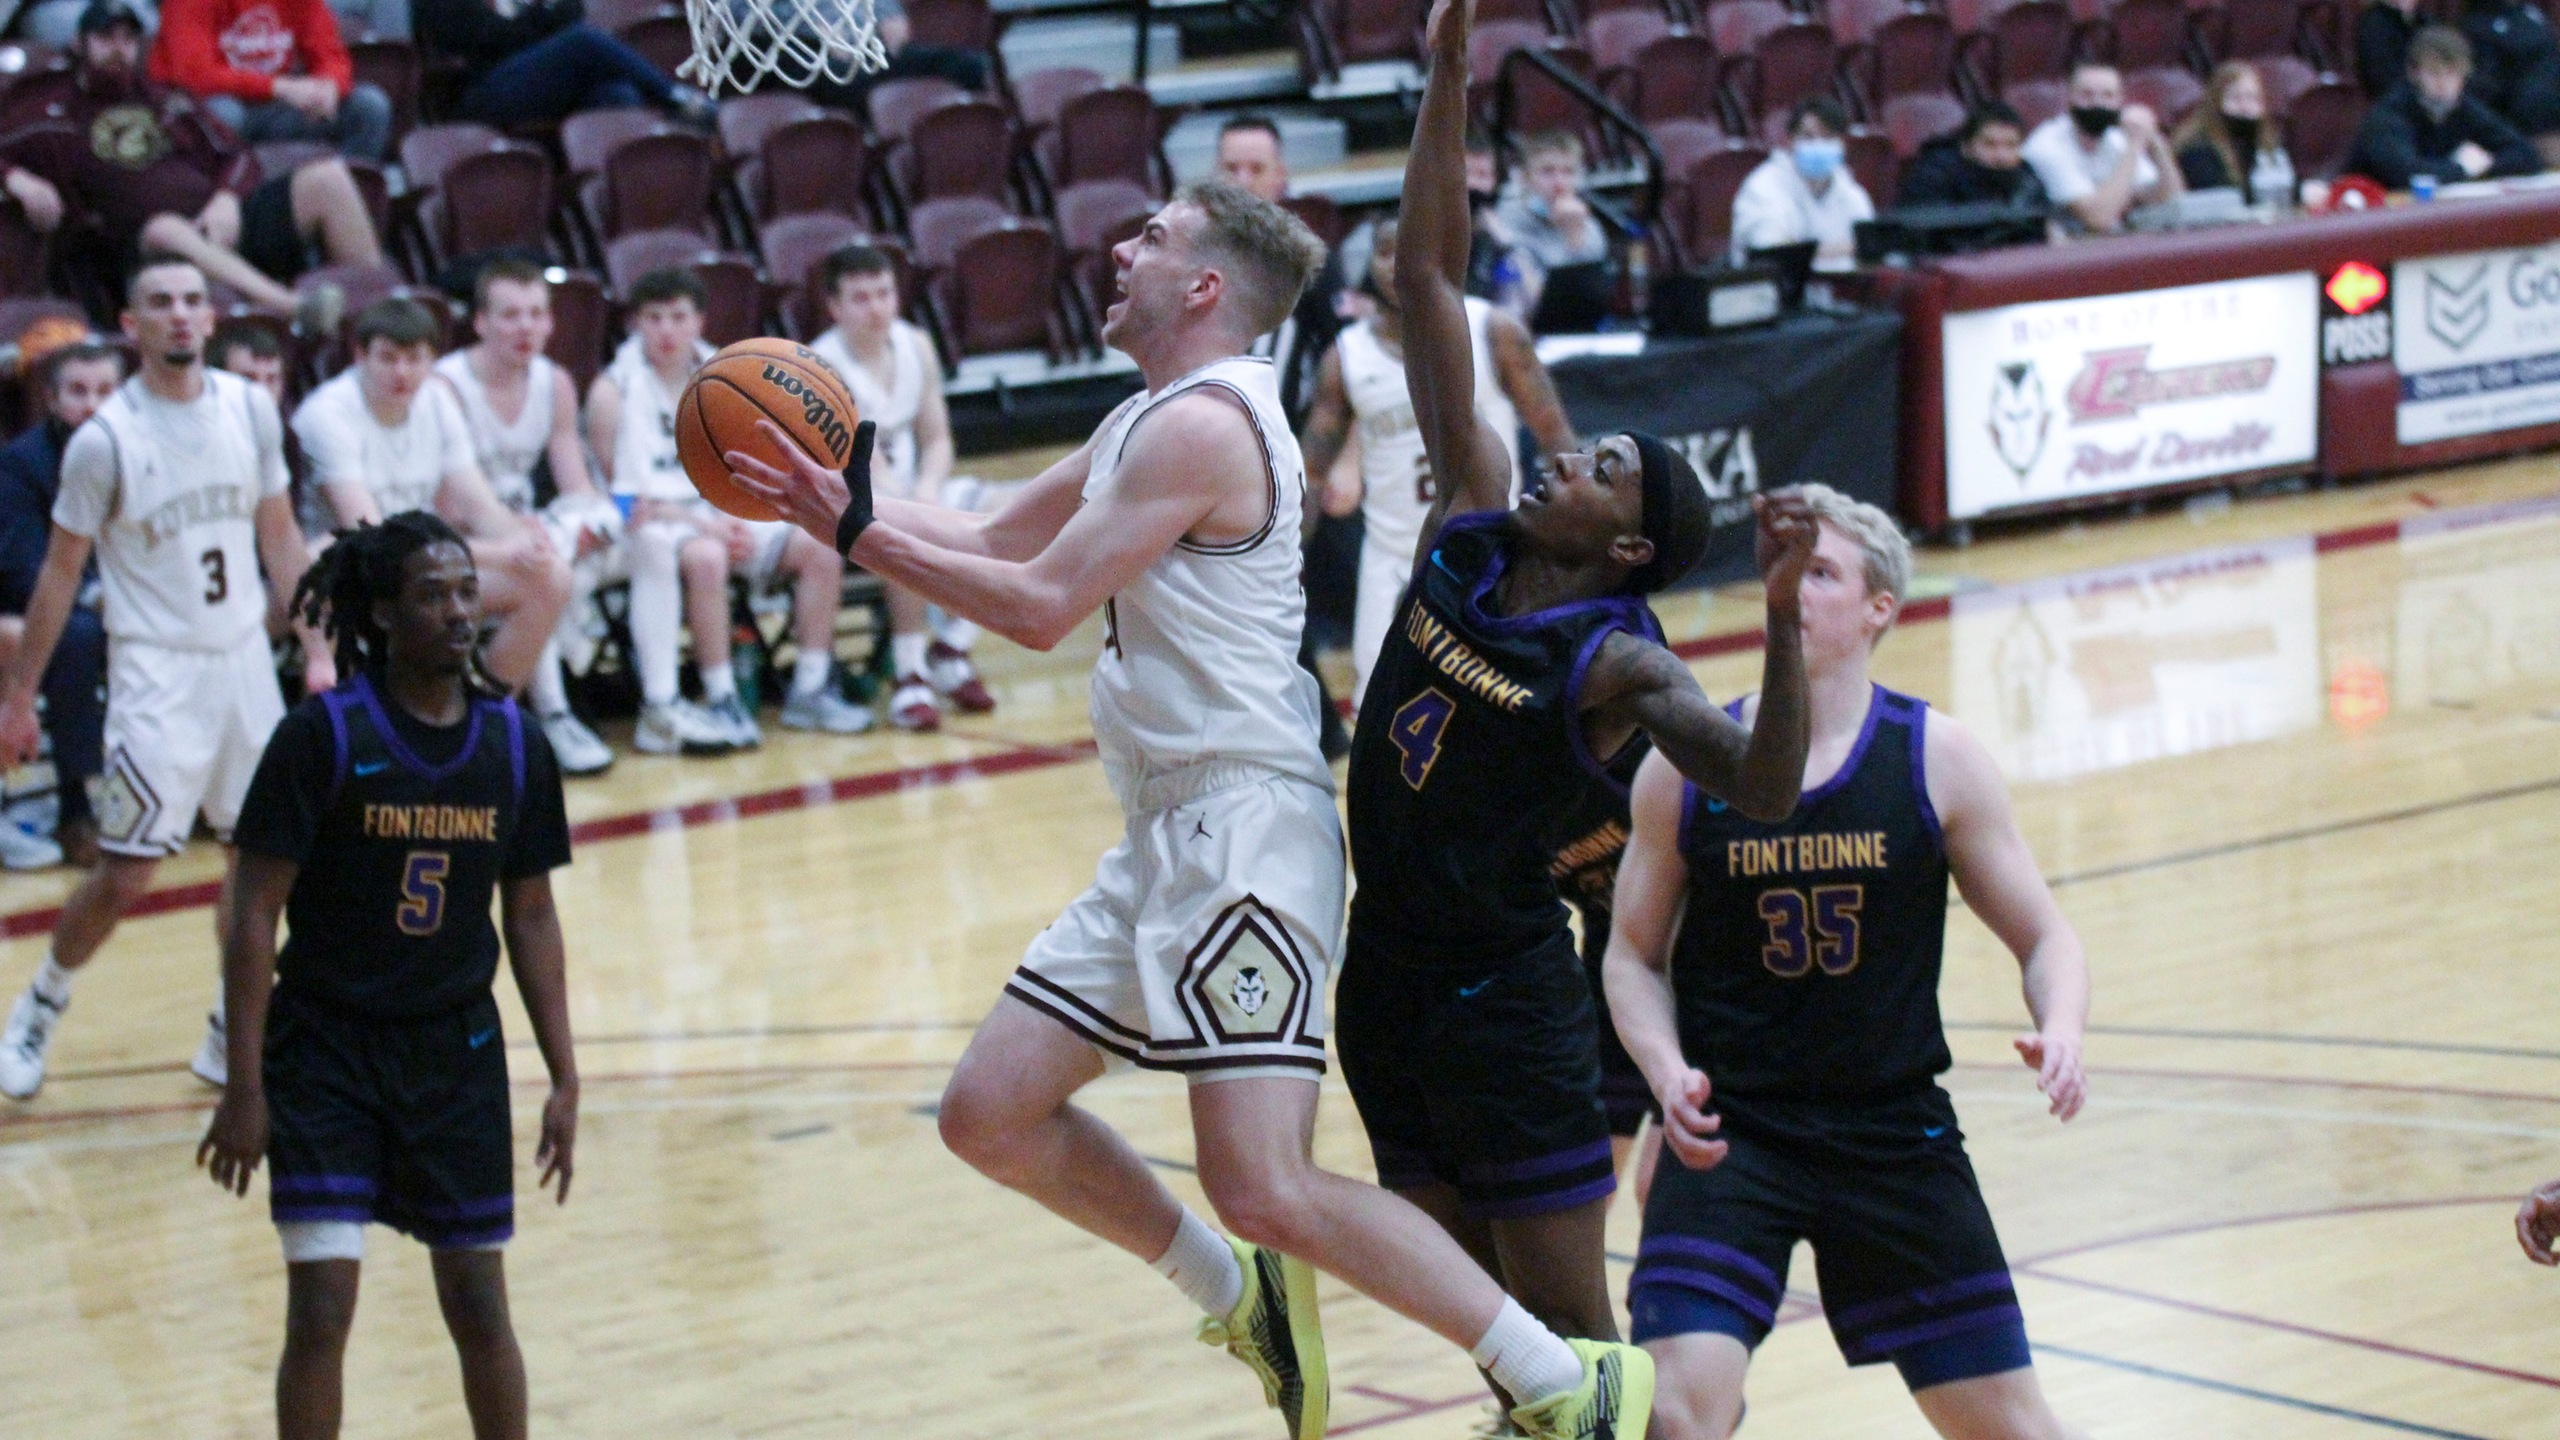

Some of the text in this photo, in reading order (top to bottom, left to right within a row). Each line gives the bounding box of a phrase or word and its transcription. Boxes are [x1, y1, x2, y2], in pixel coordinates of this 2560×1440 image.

[2323, 312, 2389, 364] POSS
[762, 363, 850, 465] Wilson
[1664, 426, 1758, 499] KA
[201, 548, 228, 606] 3
[1405, 598, 1534, 714] FONTBONNE
[1388, 685, 1457, 791] 4
[364, 804, 498, 842] FONTBONNE
[1728, 832, 1888, 877] FONTBONNE
[396, 851, 451, 936] 5
[1757, 884, 1864, 978] 35
